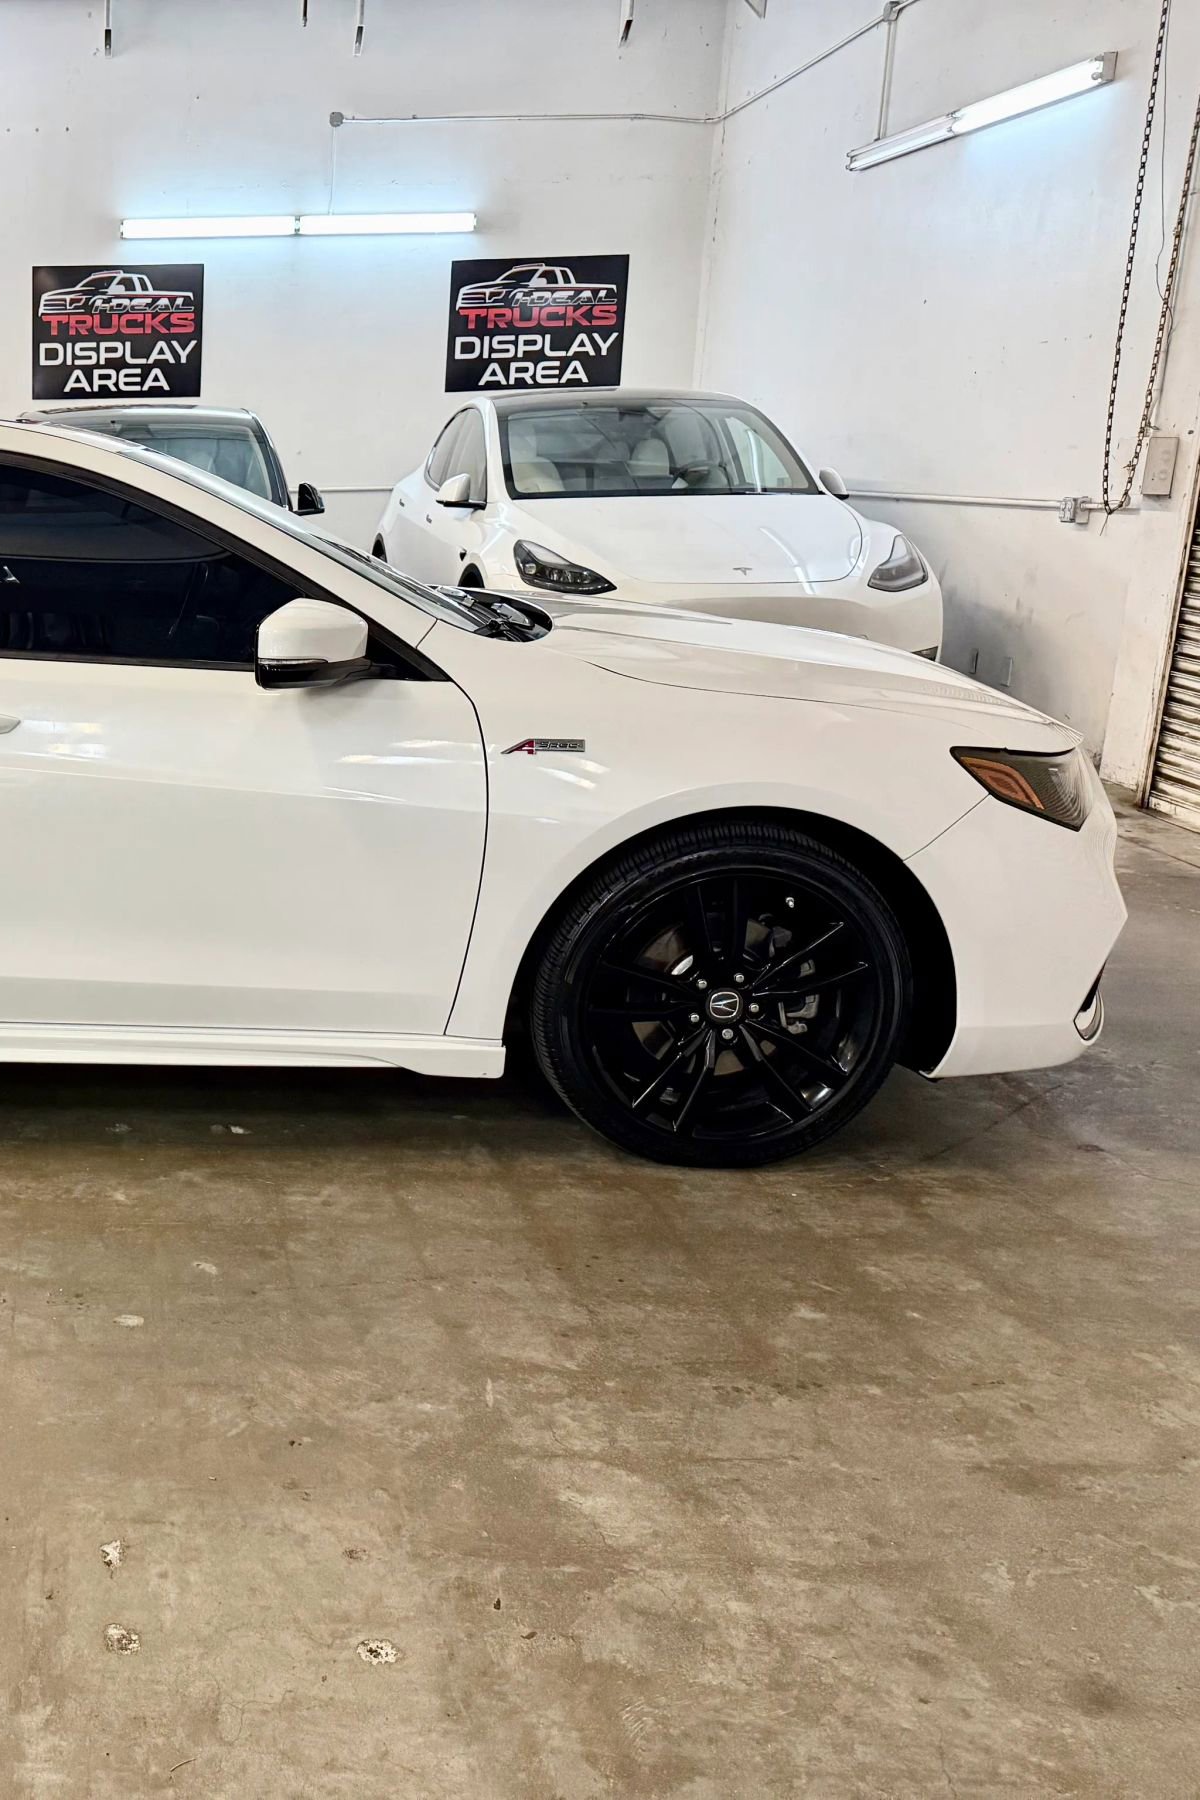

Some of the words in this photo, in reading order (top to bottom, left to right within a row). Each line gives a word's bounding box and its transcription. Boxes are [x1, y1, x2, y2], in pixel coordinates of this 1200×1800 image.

[41, 312, 195, 336] TRUCKS
[458, 305, 618, 329] TRUCKS
[39, 340, 198, 366] DISPLAY
[454, 332, 619, 360] DISPLAY
[63, 367, 171, 393] AREA
[478, 360, 590, 386] AREA
